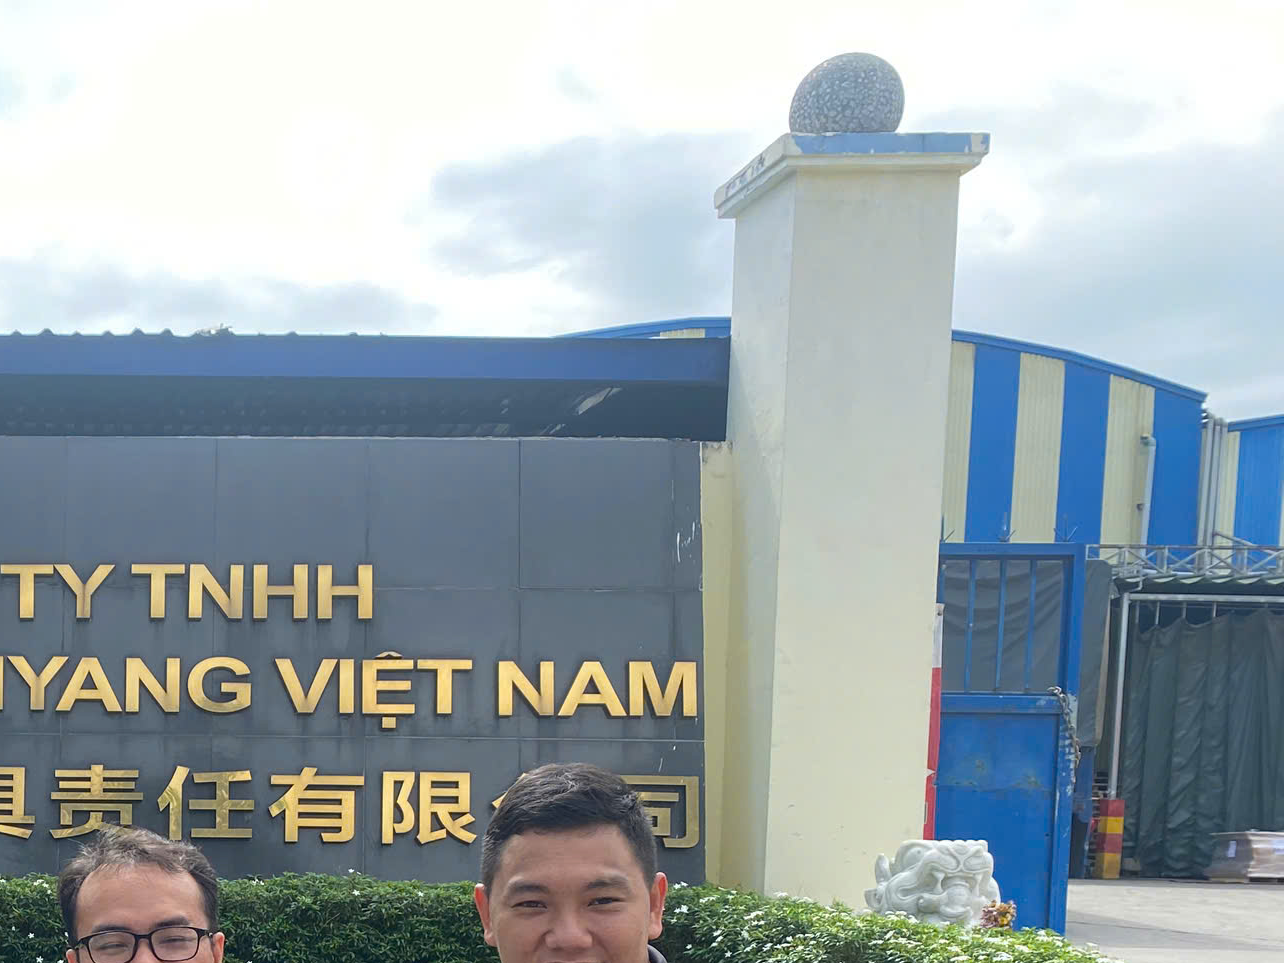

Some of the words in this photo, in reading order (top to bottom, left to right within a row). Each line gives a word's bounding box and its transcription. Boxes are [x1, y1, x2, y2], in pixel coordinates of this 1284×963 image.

[0, 562, 116, 621] TY
[130, 563, 374, 621] TNHH
[274, 650, 474, 730] VIỆT
[496, 659, 699, 719] NAM
